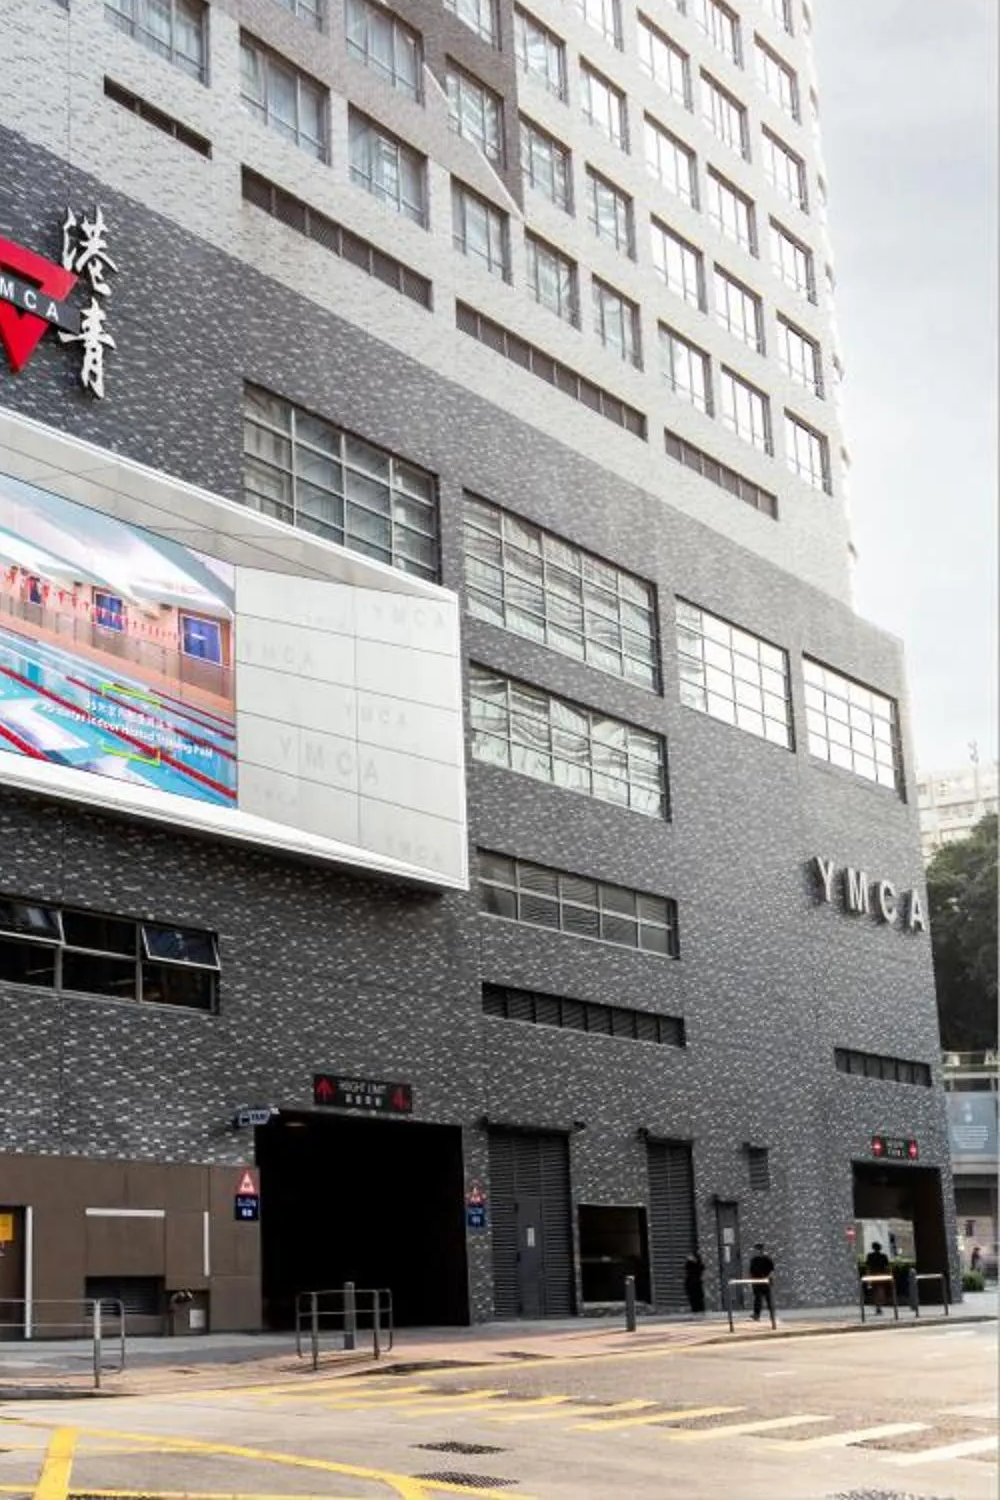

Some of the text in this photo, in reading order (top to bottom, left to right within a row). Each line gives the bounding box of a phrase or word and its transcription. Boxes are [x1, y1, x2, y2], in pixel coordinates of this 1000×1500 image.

[58, 204, 119, 398] 港青
[372, 605, 445, 629] YMCA
[243, 640, 313, 667] YMCA
[280, 736, 379, 785] YMCA
[817, 856, 926, 932] YMCA
